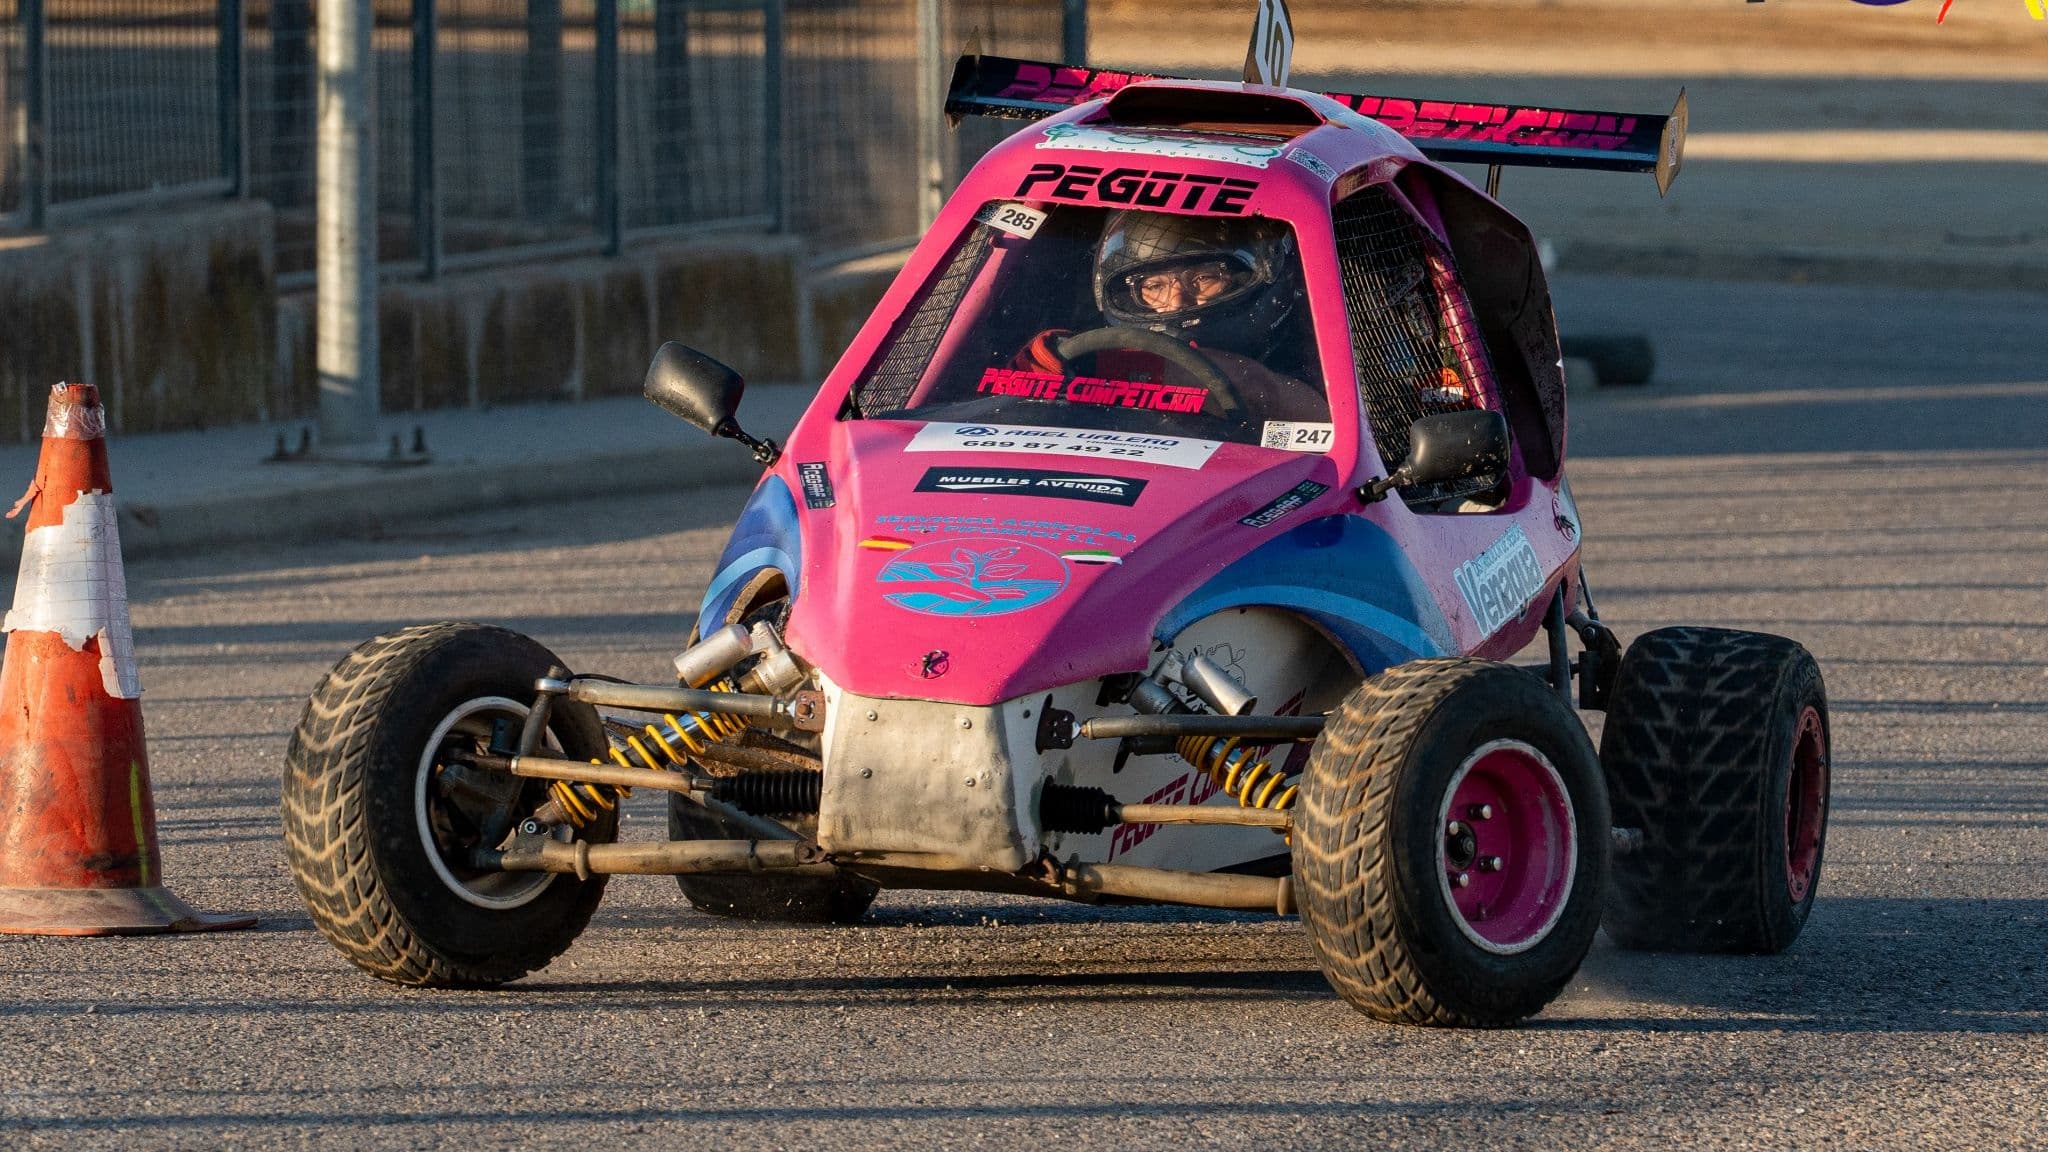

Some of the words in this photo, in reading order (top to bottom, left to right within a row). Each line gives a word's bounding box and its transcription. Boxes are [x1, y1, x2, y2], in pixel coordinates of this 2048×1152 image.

[1014, 163, 1260, 214] PEGUTE
[1000, 208, 1037, 231] 285
[977, 368, 1064, 398] PEGUTE
[1004, 429, 1069, 439] ABEL
[1295, 429, 1332, 445] 247
[962, 440, 1015, 448] 689
[1023, 442, 1059, 450] 87
[1065, 443, 1101, 453] 49
[1108, 447, 1145, 457] 22
[938, 476, 1031, 485] MUEBLES
[1035, 480, 1124, 493] AVENIDA
[876, 515, 996, 525] SERVICIOS
[895, 525, 938, 533] LOS
